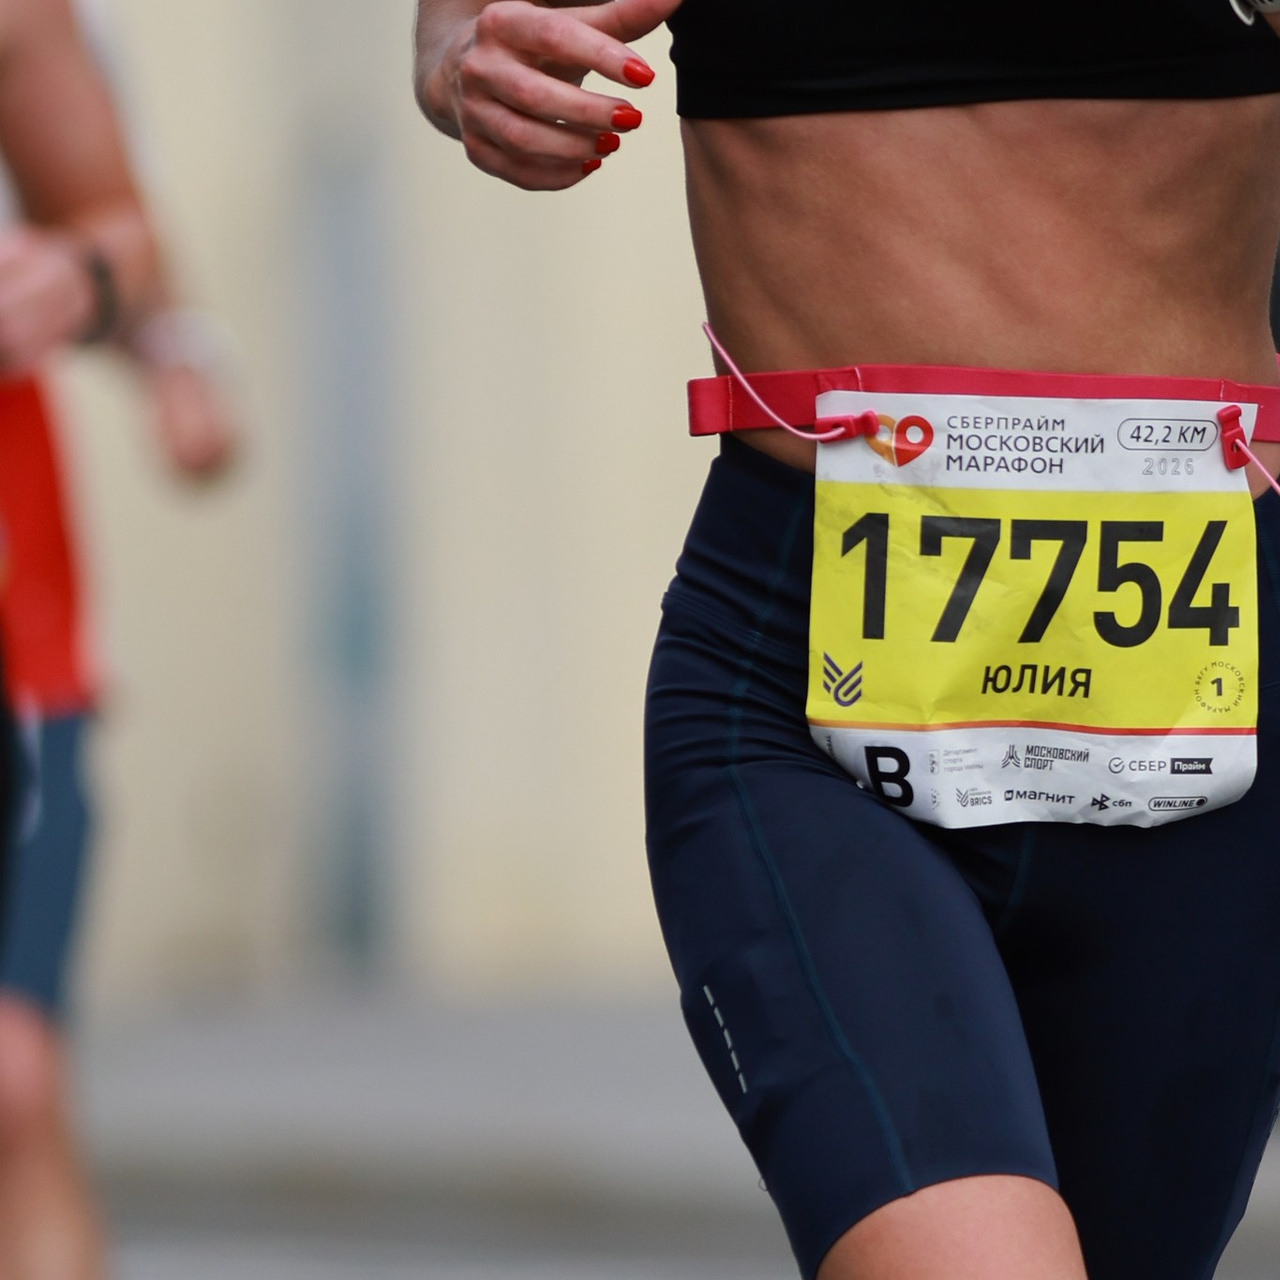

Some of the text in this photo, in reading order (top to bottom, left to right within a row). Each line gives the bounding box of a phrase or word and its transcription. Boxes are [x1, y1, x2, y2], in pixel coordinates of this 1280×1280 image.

[946, 415, 1066, 432] СБЕРПРАЙМ
[946, 433, 1105, 454] МОСКОВСКИЙ
[1130, 425, 1207, 446] 42,2 КМ
[945, 454, 1065, 475] МАРАФОН
[1141, 457, 1195, 476] 2026
[841, 512, 1241, 649] 17754
[981, 663, 1093, 699] ЮЛИЯ
[1210, 677, 1222, 696] 1
[1025, 745, 1090, 762] МОСКОВСКИЙ
[1024, 757, 1054, 770] СПОРТ
[1128, 760, 1206, 772] СБЕР Прайм
[864, 746, 914, 808] B
[970, 796, 992, 807] BRICS
[1112, 799, 1132, 807] сбп
[1153, 799, 1196, 809] WINLINE
